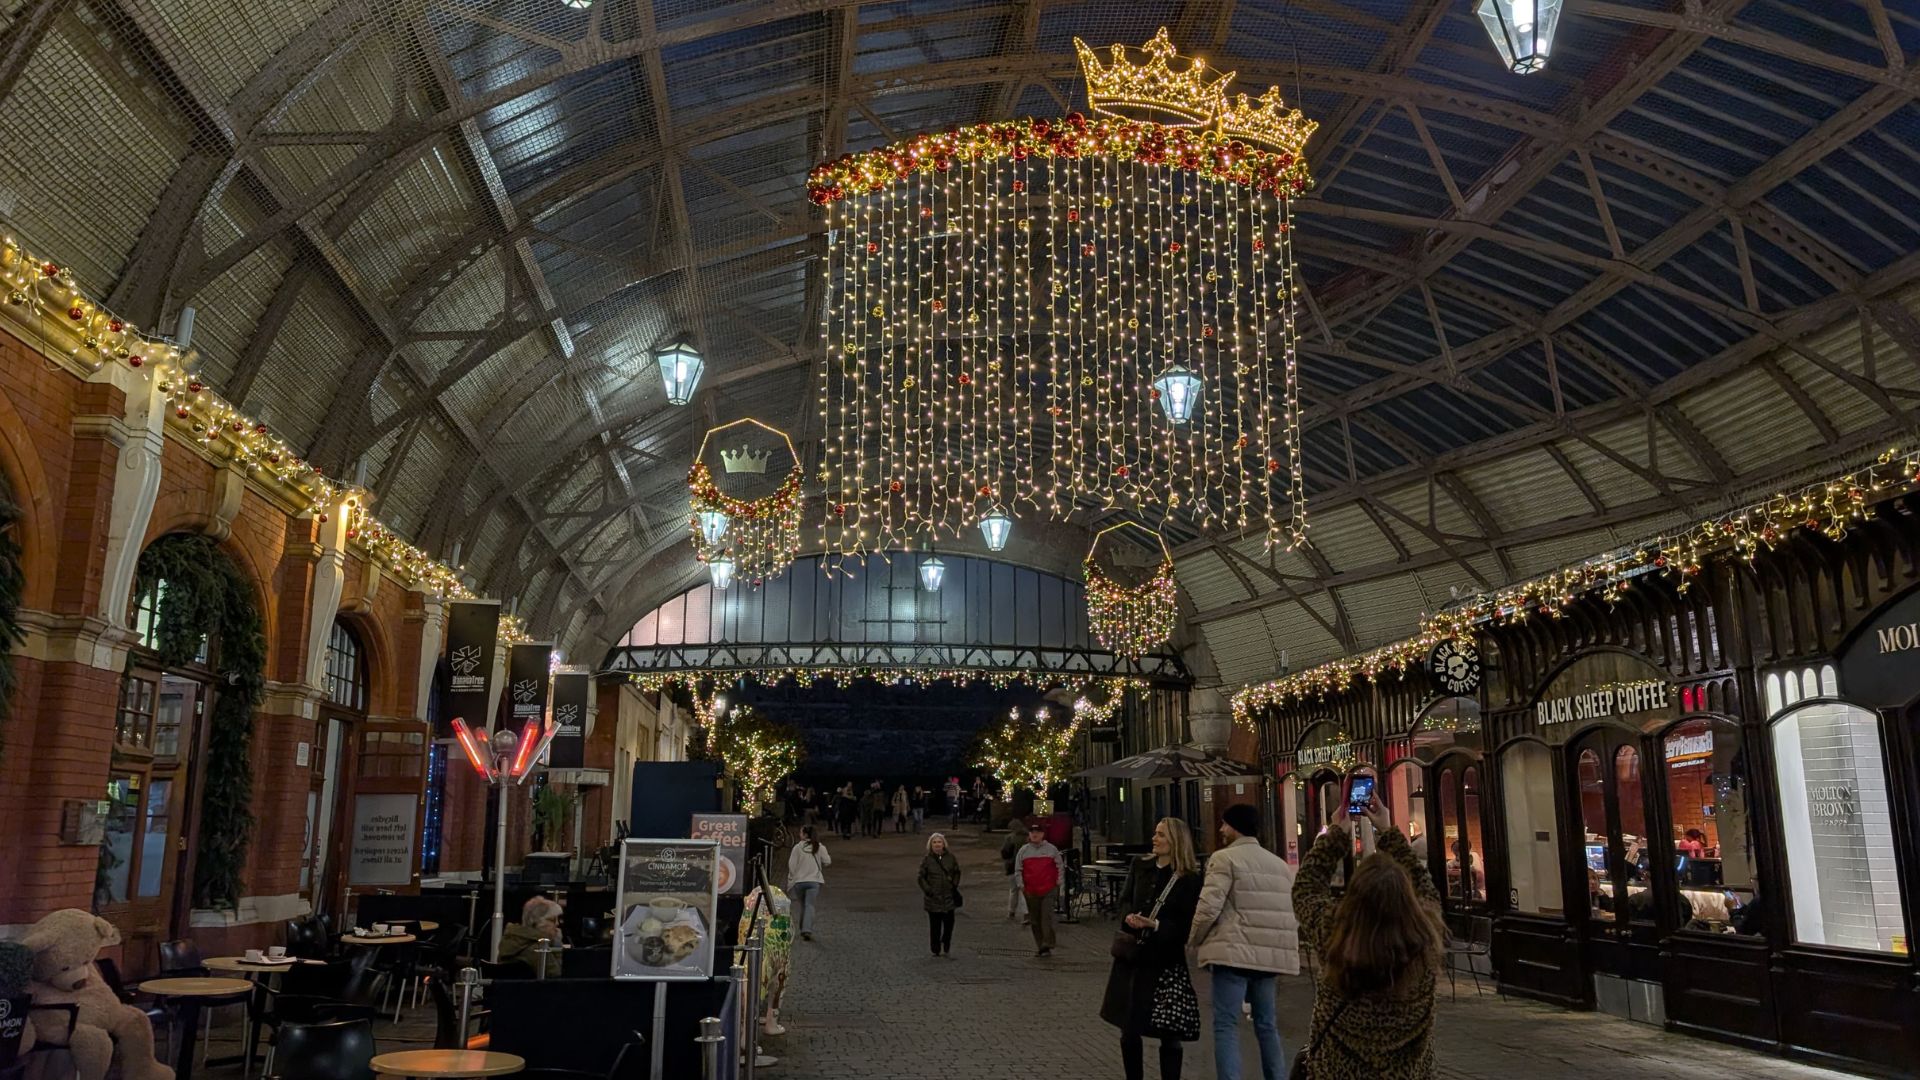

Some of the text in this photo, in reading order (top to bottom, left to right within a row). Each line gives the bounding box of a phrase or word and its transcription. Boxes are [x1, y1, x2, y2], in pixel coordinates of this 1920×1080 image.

[1435, 641, 1479, 673] BLACK SEP
[1447, 671, 1480, 693] COFFEE
[1537, 681, 1668, 725] BLACK SHEEP COFFEE
[1297, 749, 1314, 766] BLACK
[1314, 746, 1330, 763] SHEEP
[1811, 785, 1851, 800] MOLTON
[1813, 802, 1854, 816] BROWN
[699, 820, 737, 831] Great
